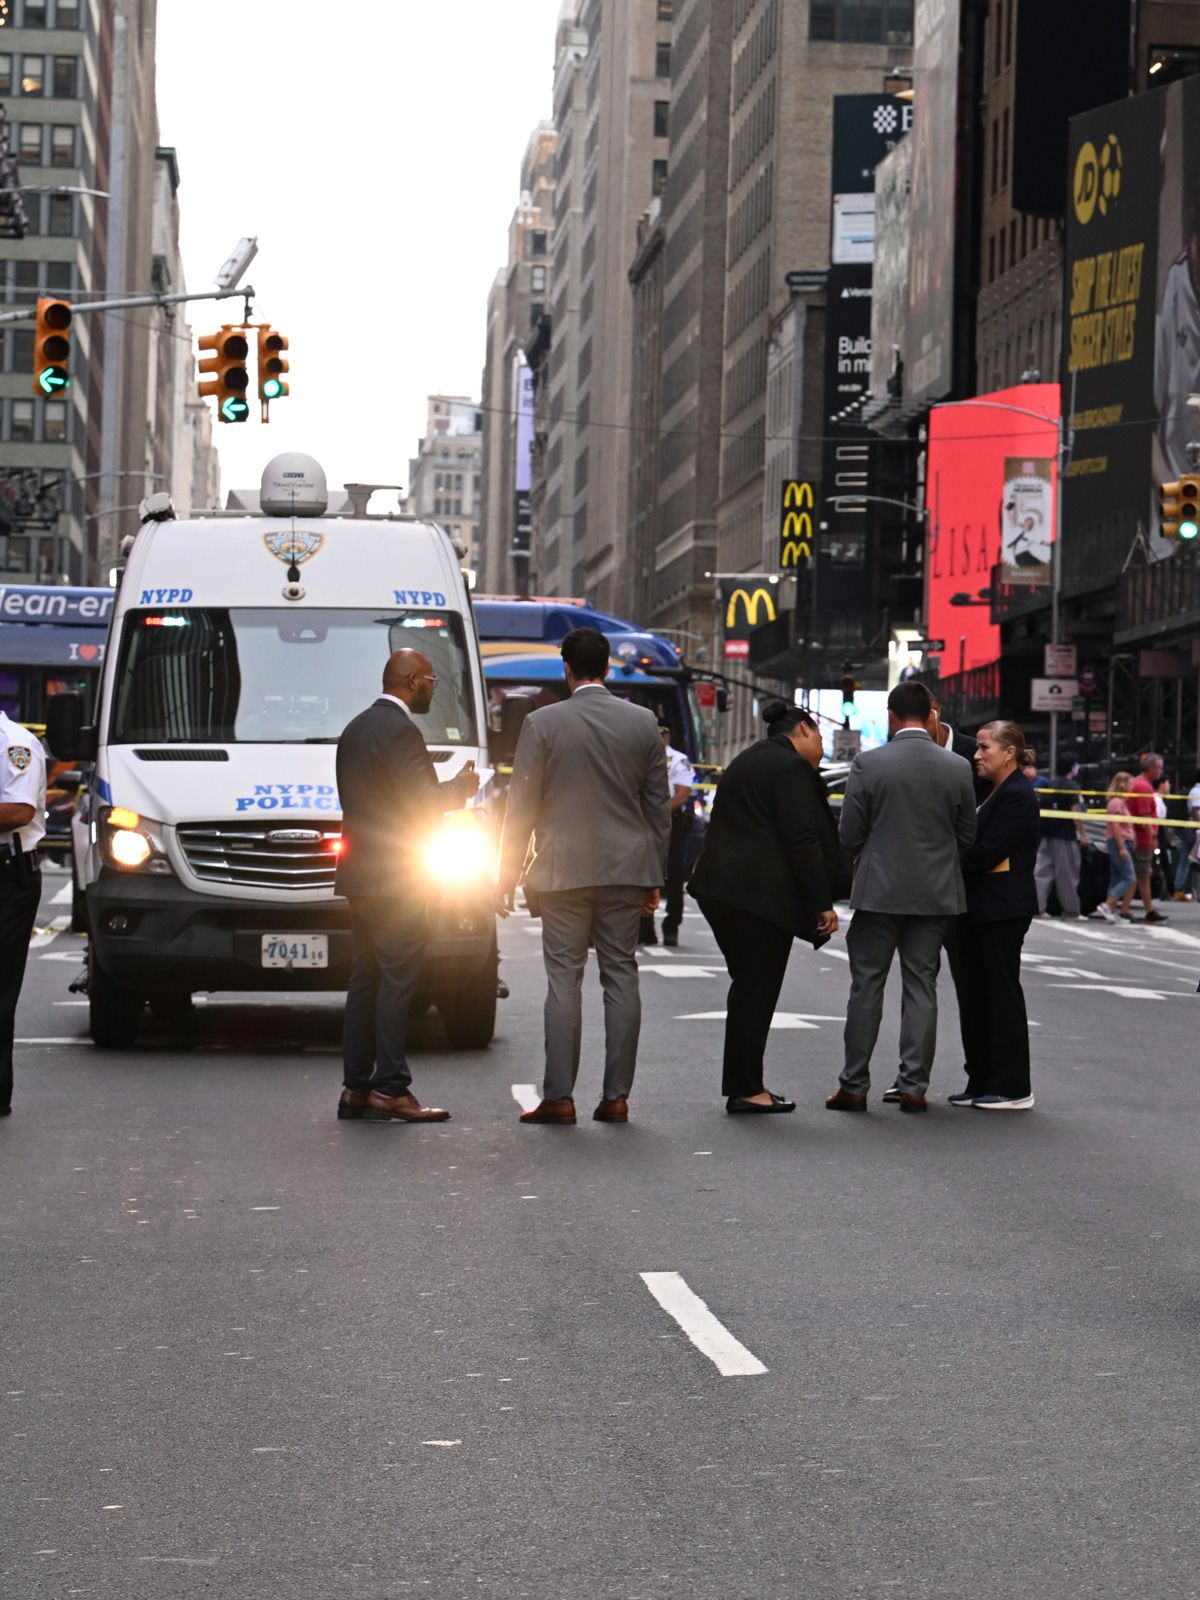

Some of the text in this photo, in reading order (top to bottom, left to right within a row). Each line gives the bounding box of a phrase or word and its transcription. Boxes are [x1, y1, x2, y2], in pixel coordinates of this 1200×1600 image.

[1069, 242, 1145, 315] SHOP THE LATEST
[1068, 302, 1137, 372] SOCCER STYLES
[139, 588, 194, 605] NYPD
[393, 590, 447, 607] NYPD
[254, 784, 335, 796] NYPD
[267, 942, 308, 960] 7041
